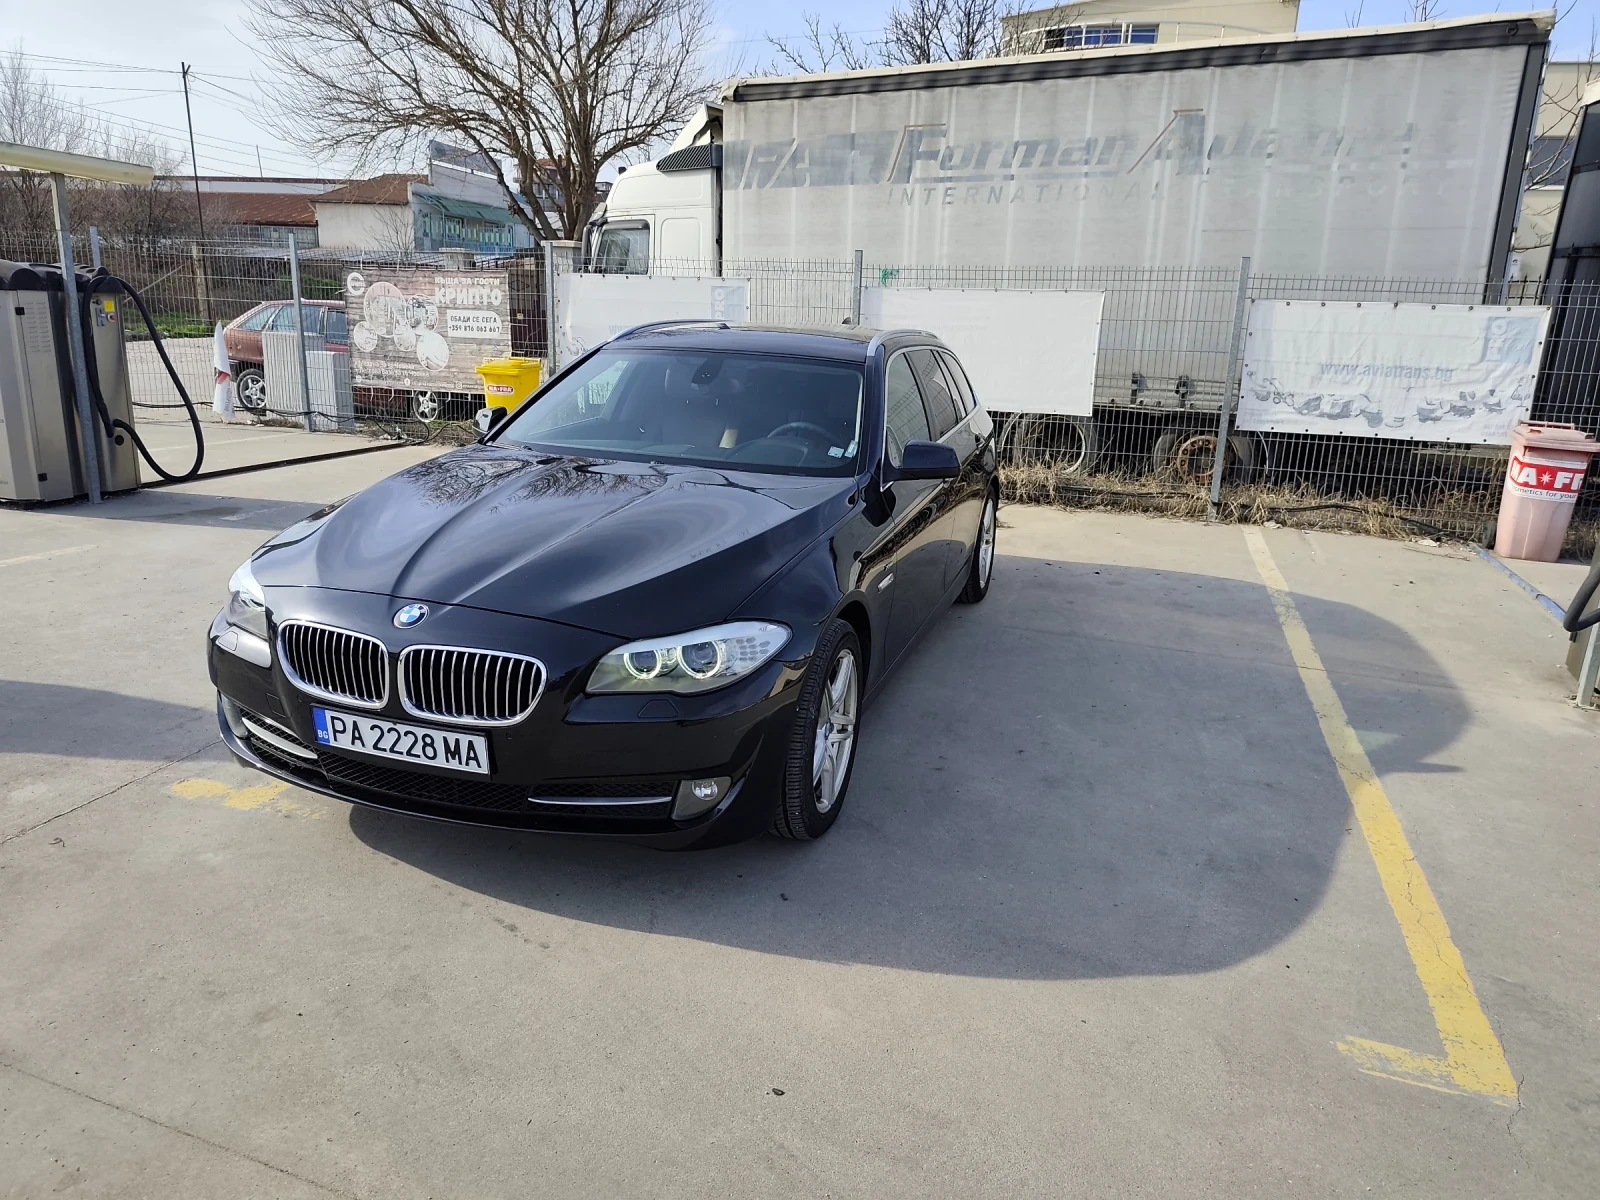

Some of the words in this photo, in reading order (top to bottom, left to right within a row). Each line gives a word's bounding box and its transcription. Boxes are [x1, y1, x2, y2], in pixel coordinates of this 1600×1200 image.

[474, 277, 500, 286] ГОСТИ
[434, 287, 502, 306] КРИПТО
[450, 315, 471, 323] ОБАДИ
[481, 316, 498, 324] СЕГА
[448, 324, 462, 332] +359
[1320, 362, 1454, 382] www.aviatrans.bg
[1546, 490, 1557, 498] for
[317, 729, 329, 739] BG
[330, 715, 366, 748] PA
[369, 724, 438, 761] 2228
[442, 735, 482, 769] MA
